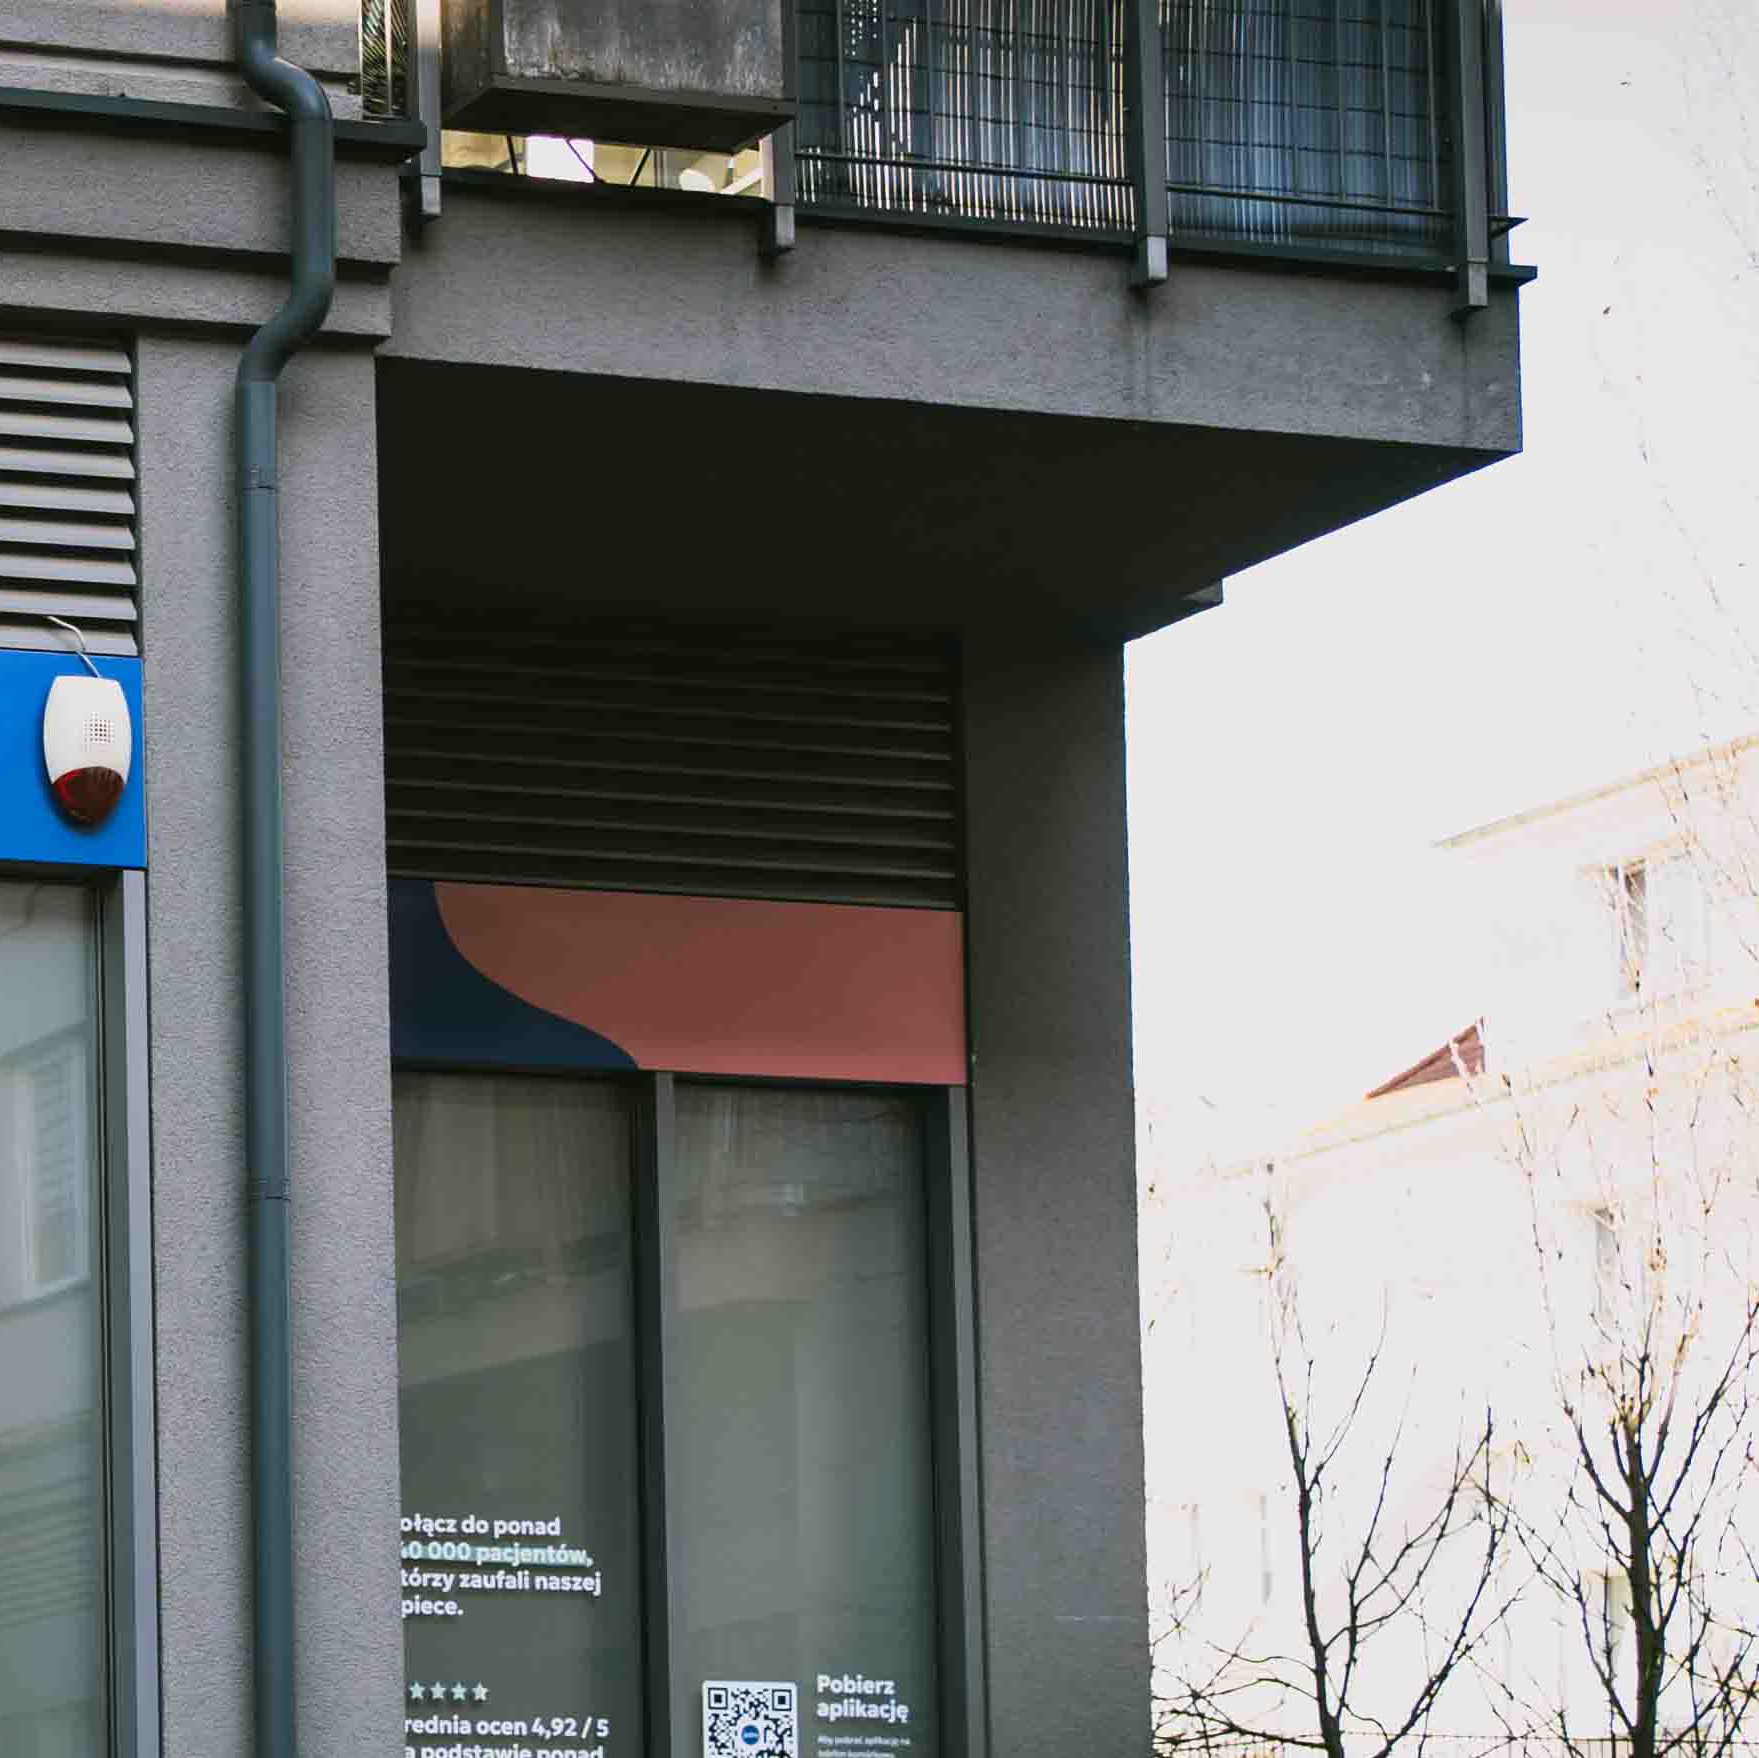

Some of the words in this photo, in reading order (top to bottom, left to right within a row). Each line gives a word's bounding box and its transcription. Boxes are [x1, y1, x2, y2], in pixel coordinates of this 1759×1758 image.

[462, 1515, 488, 1534] do
[494, 1517, 560, 1537] ponad
[428, 1542, 470, 1560] 000
[476, 1543, 593, 1567] pacjentów,
[459, 1570, 529, 1589] zaufali
[535, 1571, 601, 1596] naszej
[817, 1674, 895, 1695] Pobierz
[817, 1699, 909, 1722] aplikację
[476, 1720, 527, 1736] ocen
[531, 1718, 577, 1739] 4,92
[581, 1716, 591, 1738] /
[596, 1720, 609, 1737] 5
